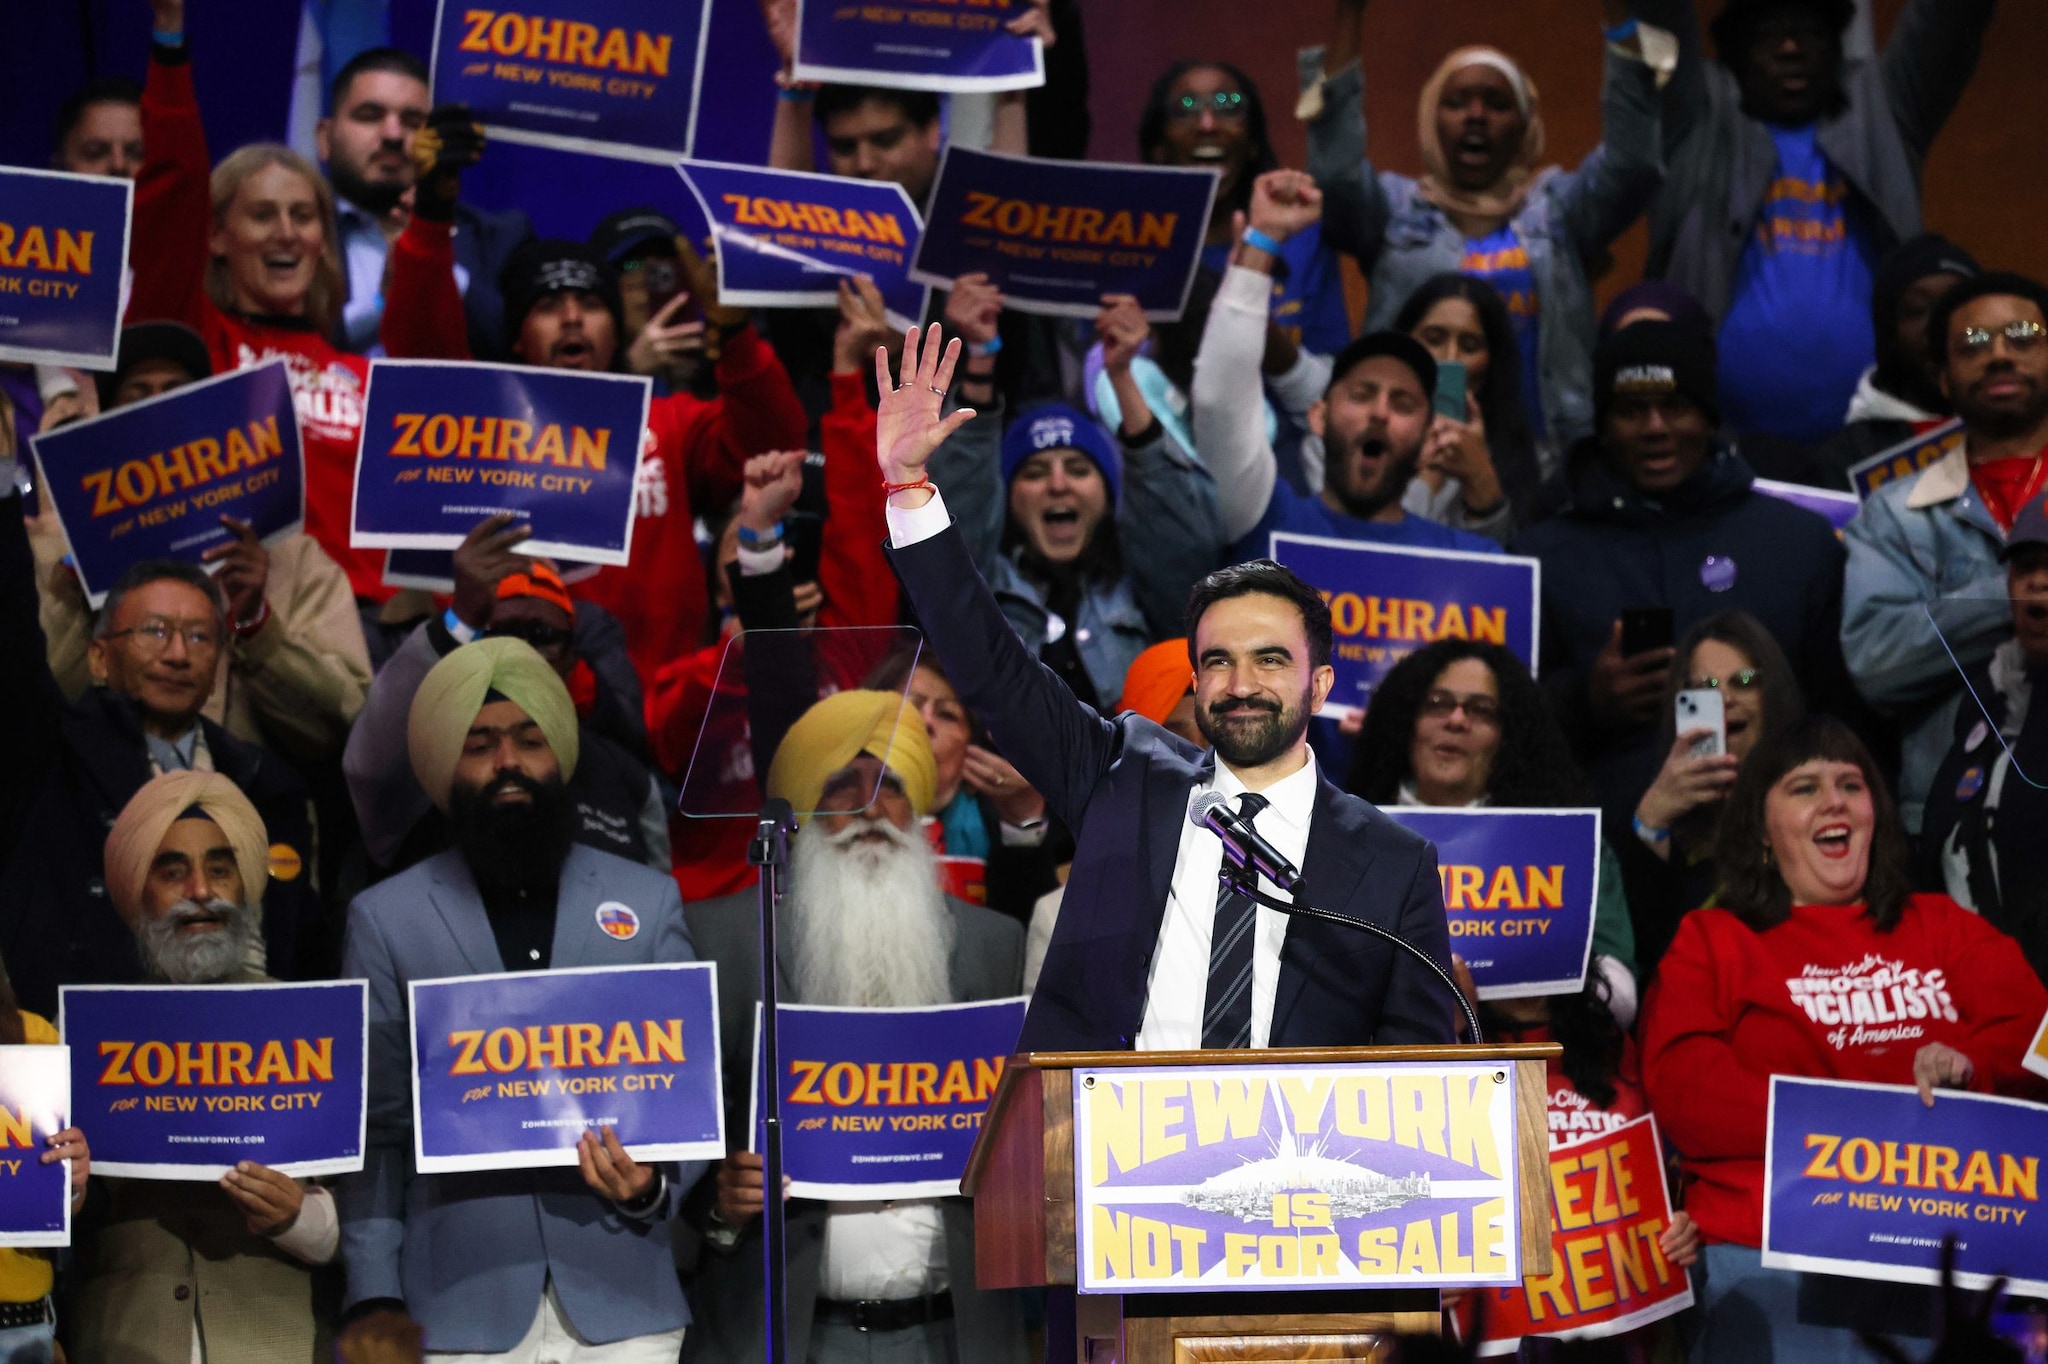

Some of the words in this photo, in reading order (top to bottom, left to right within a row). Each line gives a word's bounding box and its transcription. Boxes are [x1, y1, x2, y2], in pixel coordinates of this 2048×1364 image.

[459, 9, 672, 76] ZOHRAN
[493, 63, 545, 84] NEW
[549, 70, 604, 93] YORK
[607, 77, 656, 99] CITY
[722, 193, 906, 247] ZOHRAN
[960, 190, 1178, 249] ZOHRAN
[0, 221, 95, 276] RAN
[28, 279, 79, 299] CITY
[81, 414, 284, 520] ZOHRAN
[388, 413, 612, 472] ZOHRAN
[138, 500, 188, 528] NEW
[190, 483, 244, 511] YORK
[246, 467, 280, 494] CITY
[426, 465, 475, 484] NEW
[479, 469, 537, 488] YORK
[541, 476, 593, 495] CITY
[1338, 643, 1386, 663] NEW
[1438, 864, 1565, 911] RAN
[1447, 919, 1496, 937] ORK
[1501, 918, 1551, 936] CITY
[97, 1037, 334, 1087] ZOHRAN
[448, 1019, 686, 1076] ZOHRAN
[1827, 1026, 1847, 1050] of
[1850, 1024, 1924, 1046] America
[109, 1098, 139, 1113] FOR
[145, 1095, 198, 1112] NEW
[203, 1095, 266, 1113] YORK
[271, 1092, 322, 1111] CITY
[462, 1086, 492, 1103] FOR
[498, 1081, 550, 1099] NEW
[556, 1077, 617, 1095] YORK
[622, 1074, 675, 1092] CITY
[788, 1056, 1006, 1107] ZOHRAN
[167, 1135, 265, 1144] ZOHRANFORNYC.COM
[831, 1115, 885, 1132] NEW
[889, 1114, 947, 1131] YORK
[951, 1111, 987, 1129] CIT
[1089, 1077, 1270, 1187] NEW
[1277, 1074, 1503, 1181] YORK
[1548, 1110, 1628, 1131] RATIC
[1550, 1141, 1640, 1232] EZE
[1802, 1133, 2040, 1201] ZOHRAN
[1272, 1192, 1331, 1229] IS
[1812, 1192, 1843, 1206] FOR
[1848, 1192, 1902, 1213] NEW
[1908, 1197, 1969, 1219] YORK
[1974, 1204, 2027, 1226] CITY
[1093, 1203, 1206, 1280] NOT
[1225, 1232, 1341, 1278] FOR
[1359, 1196, 1507, 1275] SALE
[1523, 1219, 1670, 1322] RENT
